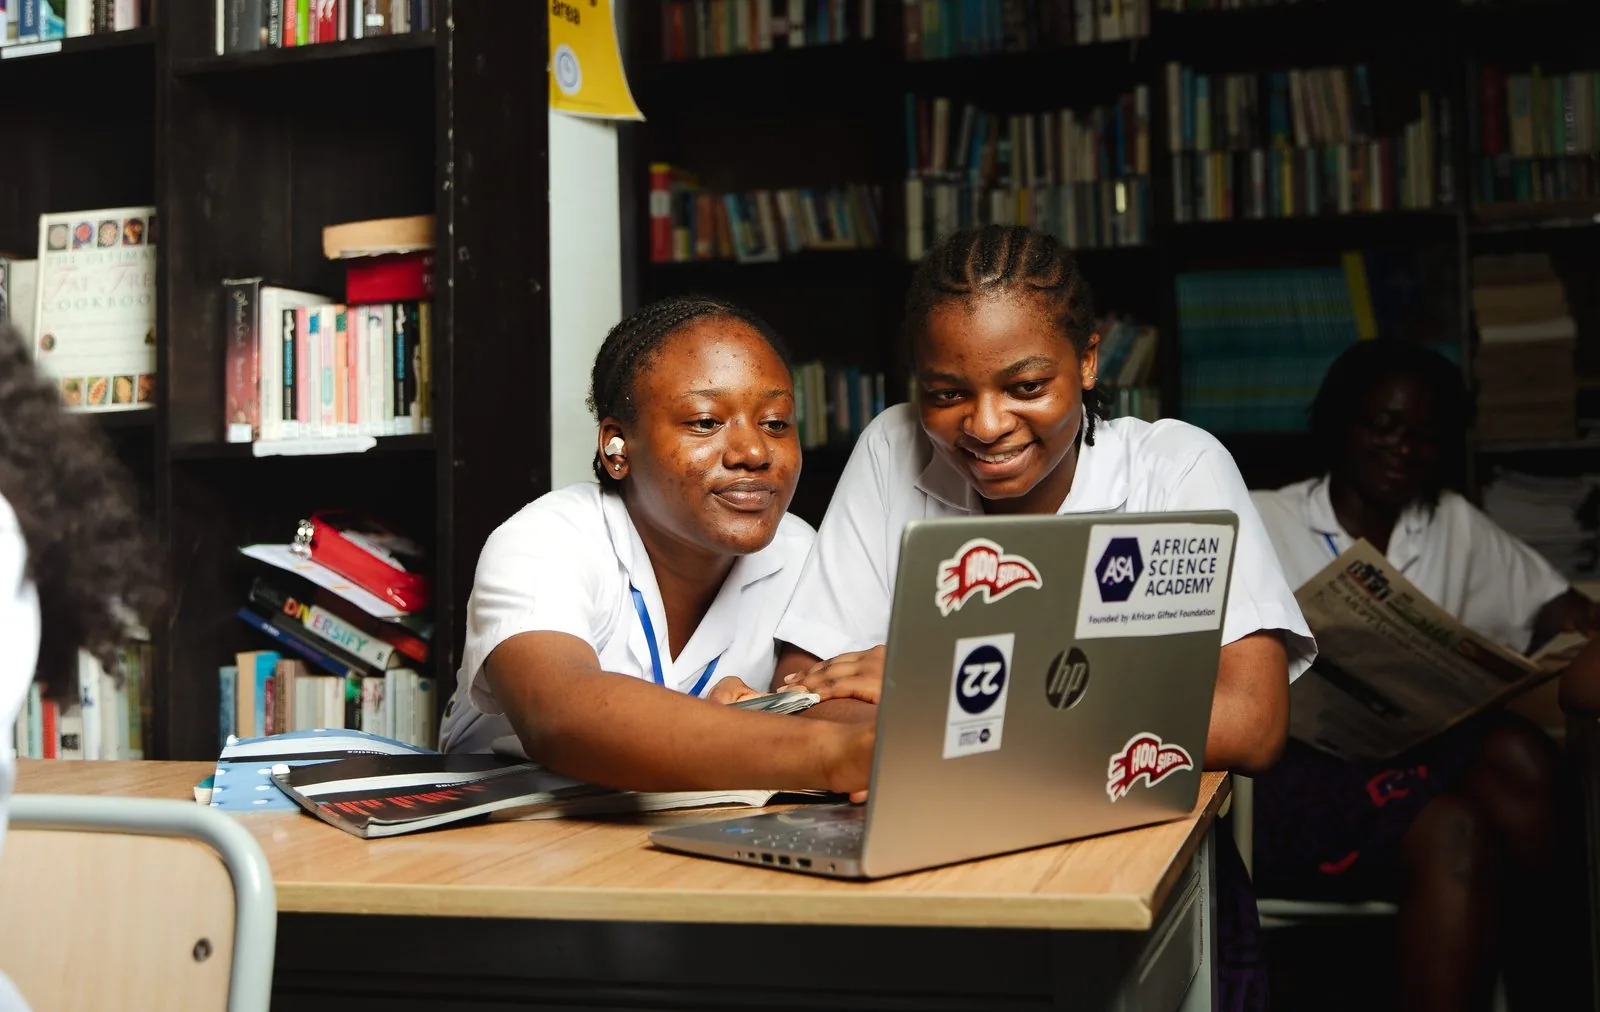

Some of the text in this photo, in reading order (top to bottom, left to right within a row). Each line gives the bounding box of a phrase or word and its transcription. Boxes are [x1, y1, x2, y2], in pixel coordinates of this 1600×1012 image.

[551, 0, 581, 25] area
[267, 20, 278, 44] LEWIS
[1150, 537, 1220, 556] AFRICAN
[1102, 555, 1135, 584] ASA
[1148, 557, 1217, 577] SCIENCE
[1145, 577, 1214, 597] ACADEMY
[282, 596, 369, 652] DIVERSIFY
[1088, 608, 1216, 625] Founded by African Gifted Foundation
[961, 661, 1002, 698] 22
[1048, 649, 1087, 712] hp
[1131, 742, 1158, 775] HOO
